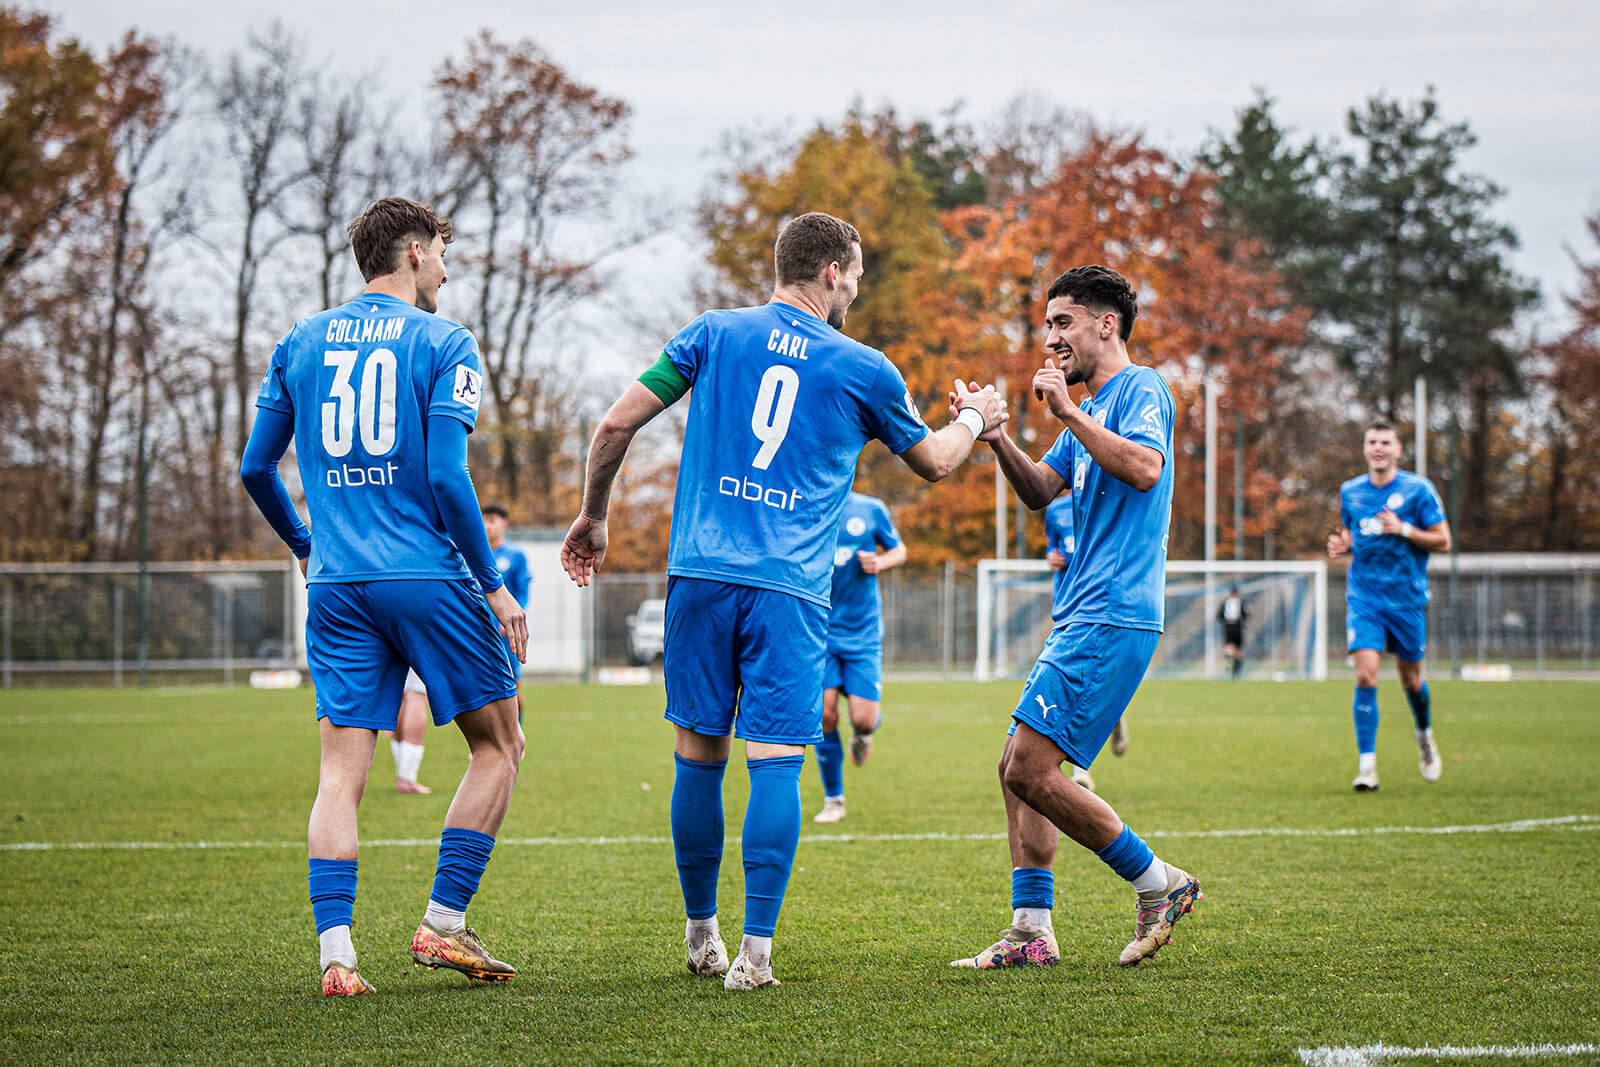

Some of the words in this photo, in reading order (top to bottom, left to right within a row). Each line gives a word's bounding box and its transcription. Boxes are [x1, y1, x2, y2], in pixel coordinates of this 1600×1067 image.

[326, 316, 407, 343] COLLMANN
[767, 328, 809, 361] CARL
[321, 348, 397, 458] 30
[751, 364, 800, 470] 9
[326, 461, 399, 488] abat
[719, 475, 803, 512] abat
